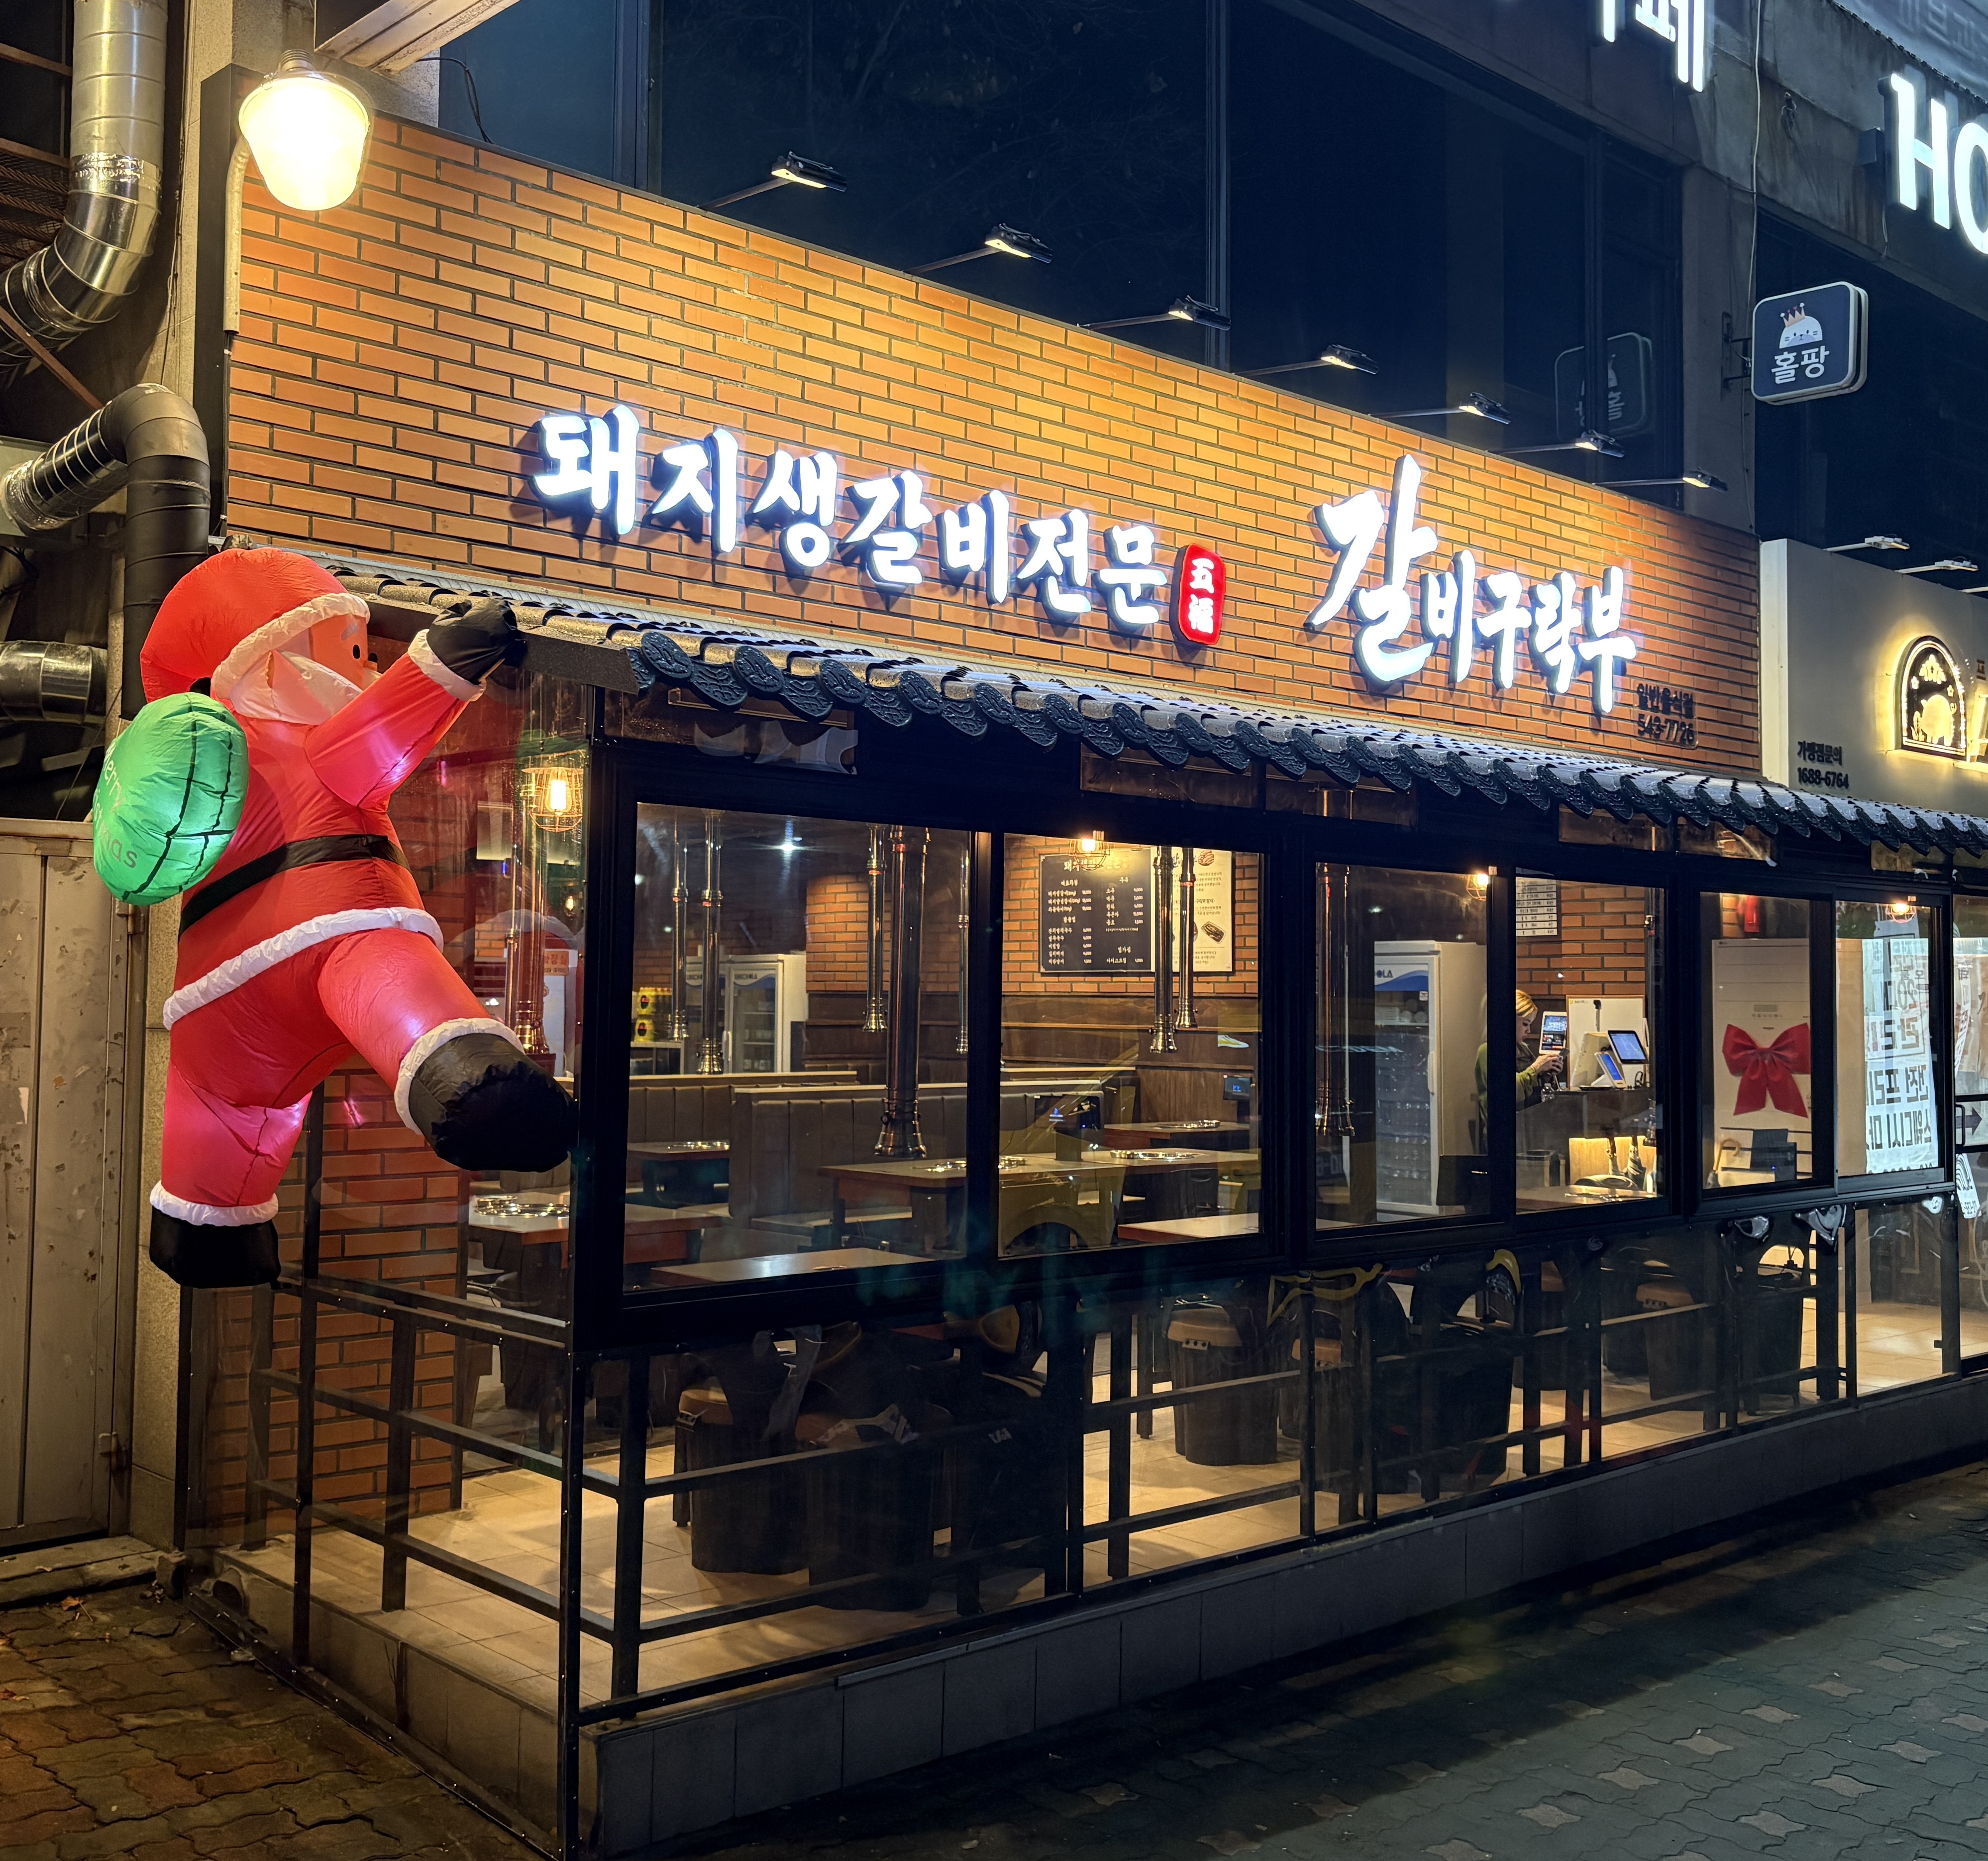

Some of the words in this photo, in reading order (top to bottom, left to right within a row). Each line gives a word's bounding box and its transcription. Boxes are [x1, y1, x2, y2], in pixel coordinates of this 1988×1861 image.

[1772, 345, 1830, 384] 홀팡
[1312, 454, 1637, 713] 갈비구락부
[1797, 767, 1849, 789] 1688-6764
